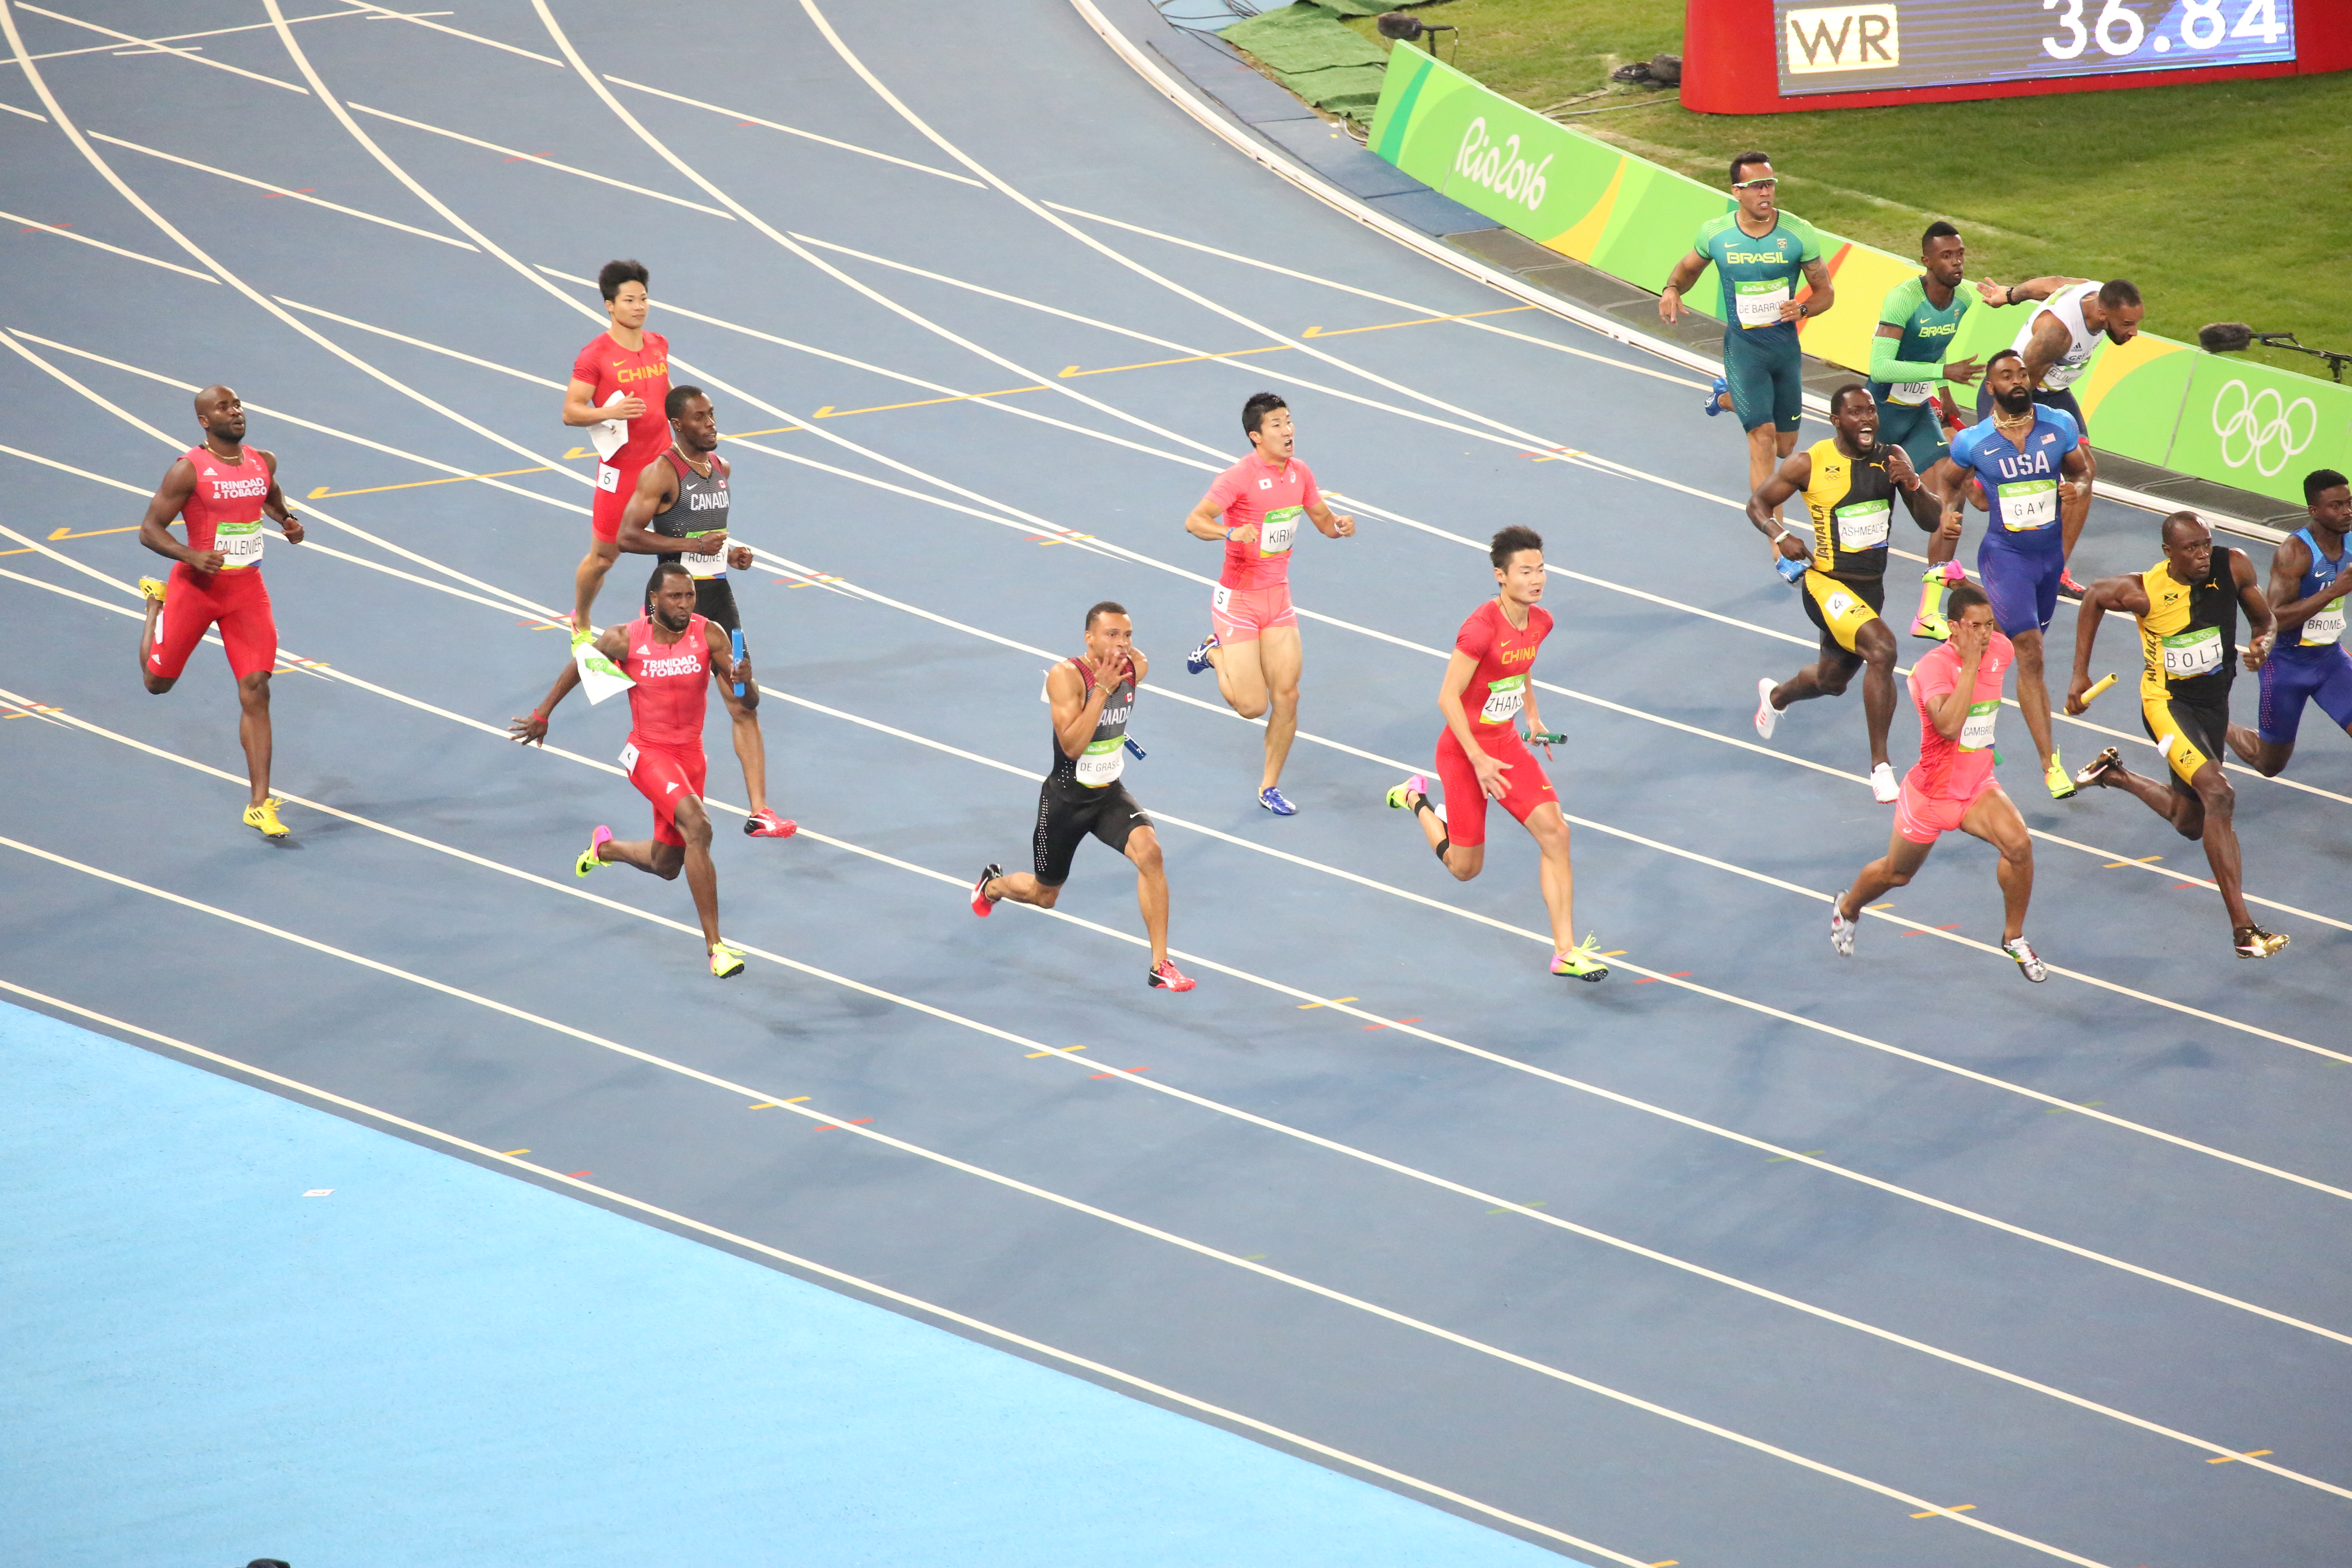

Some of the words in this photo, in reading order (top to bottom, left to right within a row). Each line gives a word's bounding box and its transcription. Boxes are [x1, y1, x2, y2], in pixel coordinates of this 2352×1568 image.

[1791, 15, 1892, 65] WR
[2042, 0, 2287, 59] 36.84
[1455, 117, 1553, 210] Rio2016
[1727, 252, 1788, 264] BRASIL
[1739, 305, 1749, 313] DE
[1918, 323, 1956, 338] BRASIL
[617, 363, 668, 383] CHINA
[1904, 381, 1930, 394] VIDE
[1998, 450, 2051, 479] USA
[212, 477, 264, 490] TRINIDAD
[604, 472, 611, 485] 6
[221, 486, 267, 499] TOBAGO
[2006, 486, 2031, 494] Rio2016
[690, 490, 730, 511] CANADA
[2015, 501, 2045, 516] GAY
[1811, 505, 1829, 560] JAMAICA
[1841, 522, 1884, 537] ASHMEADE
[642, 655, 697, 668] TRINIDAD
[1501, 646, 1536, 664] CHINA
[2166, 643, 2220, 668] BOLT
[649, 663, 702, 678] TOBAGO
[1097, 705, 1131, 726] ANADA
[1080, 762, 1092, 771] DE
